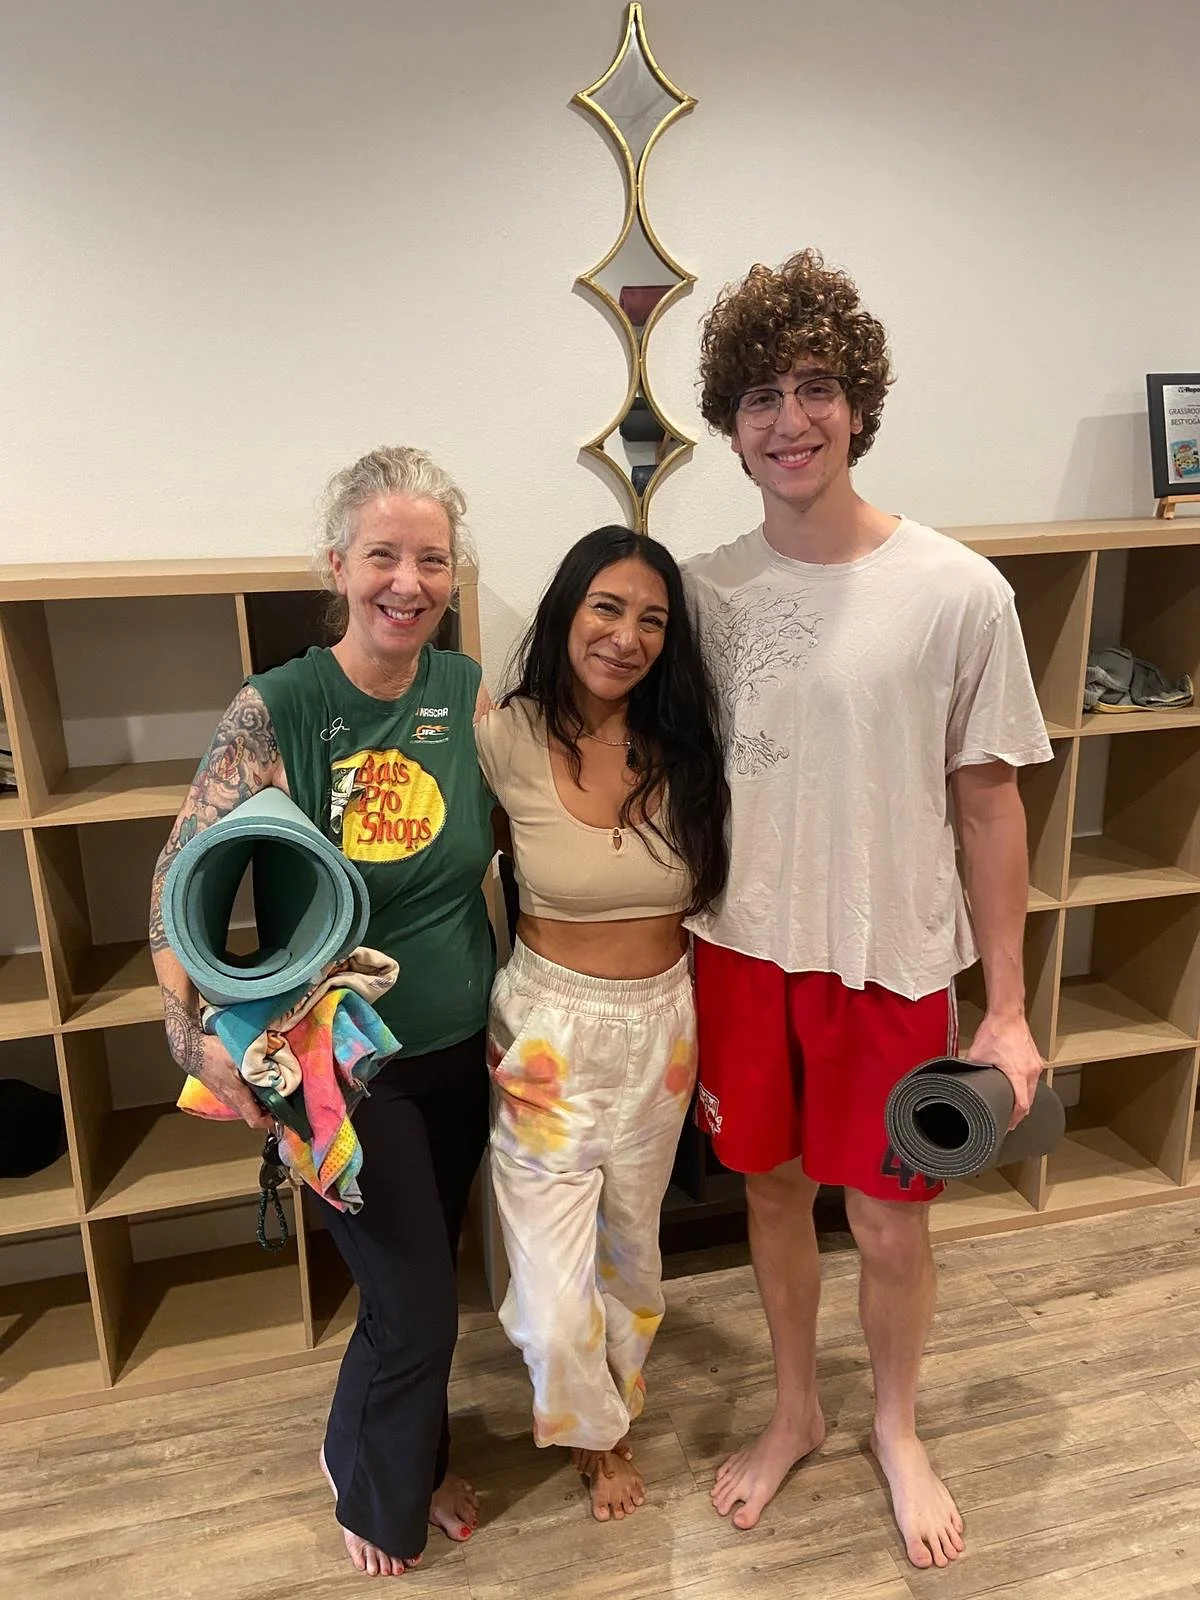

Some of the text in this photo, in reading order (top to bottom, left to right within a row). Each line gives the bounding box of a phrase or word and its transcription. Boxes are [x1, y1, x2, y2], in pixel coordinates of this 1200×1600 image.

[418, 707, 449, 718] NASCAR
[355, 754, 410, 785] Bass
[355, 785, 403, 814] Pro
[357, 812, 432, 851] Shops
